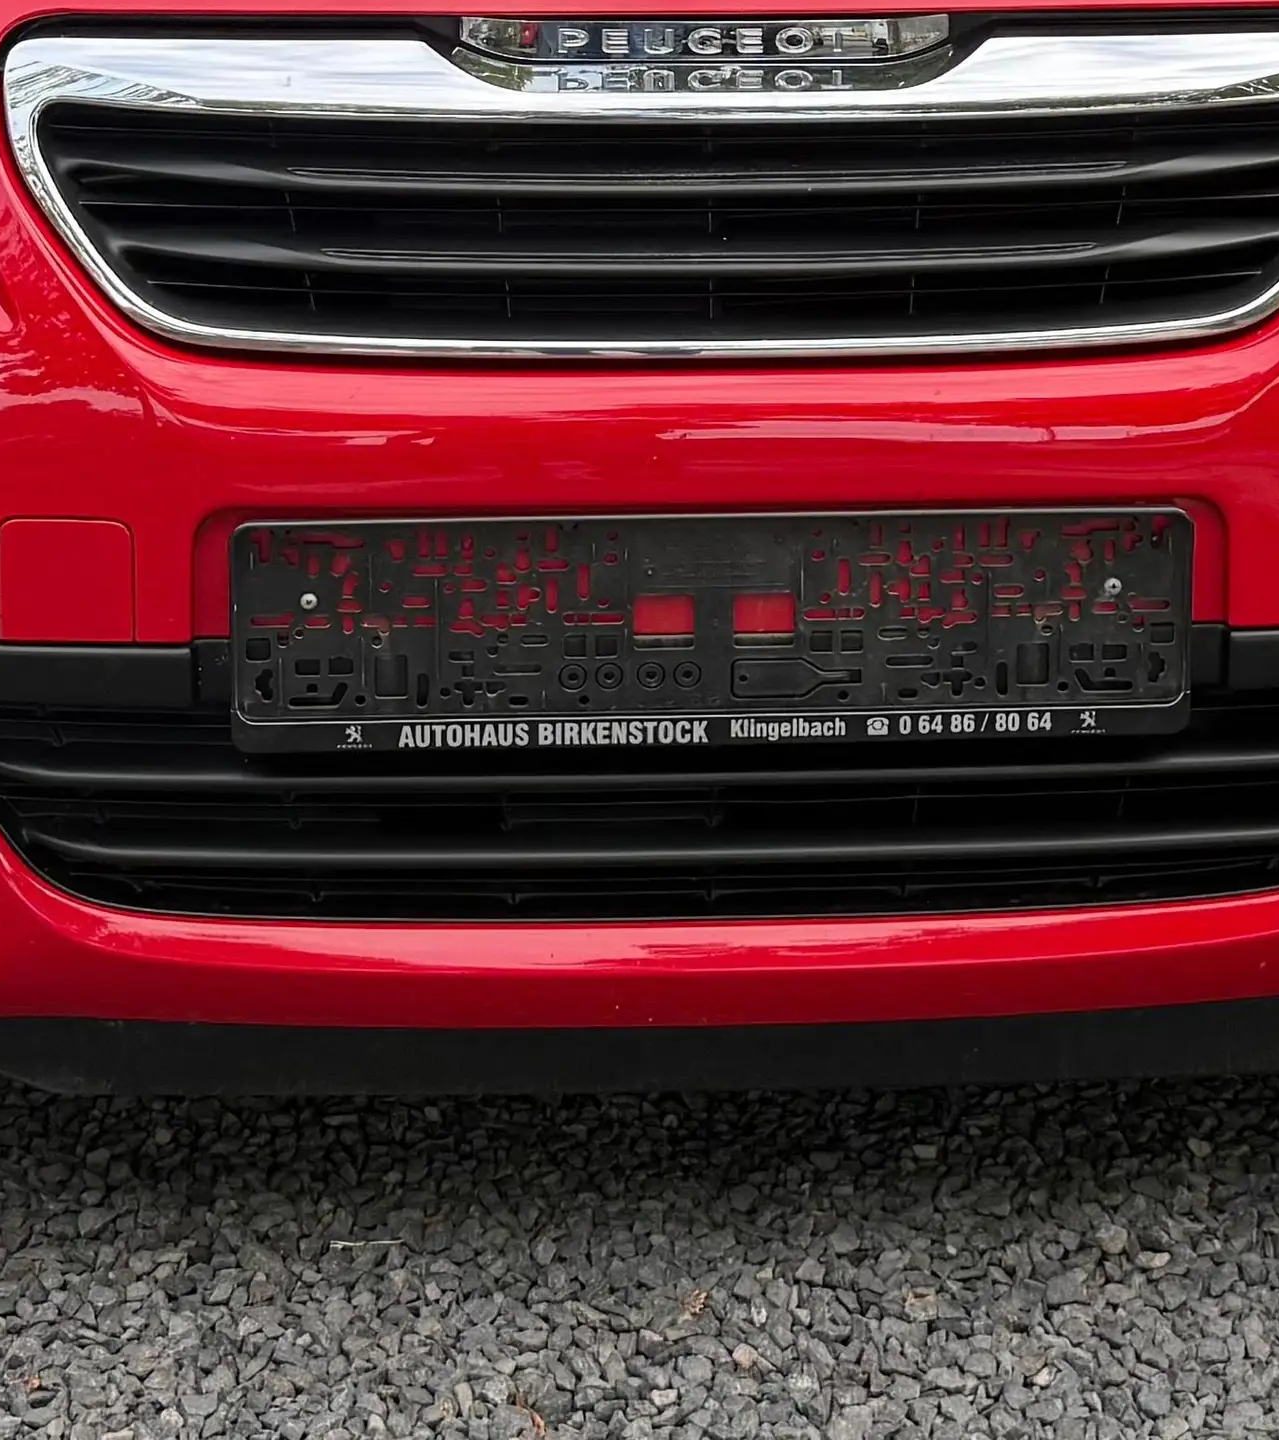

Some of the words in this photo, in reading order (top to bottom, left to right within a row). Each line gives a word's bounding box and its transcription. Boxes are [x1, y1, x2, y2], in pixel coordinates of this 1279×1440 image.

[557, 27, 853, 55] PEUGEOT
[398, 723, 530, 748] AUTOHAUS
[538, 720, 709, 745] BIRKENSTOCK
[730, 717, 846, 741] Klingelbach
[899, 715, 911, 734] 0
[918, 714, 943, 734] 64
[950, 714, 975, 733] 86
[995, 712, 1020, 732] 80
[1027, 712, 1052, 731] 64
